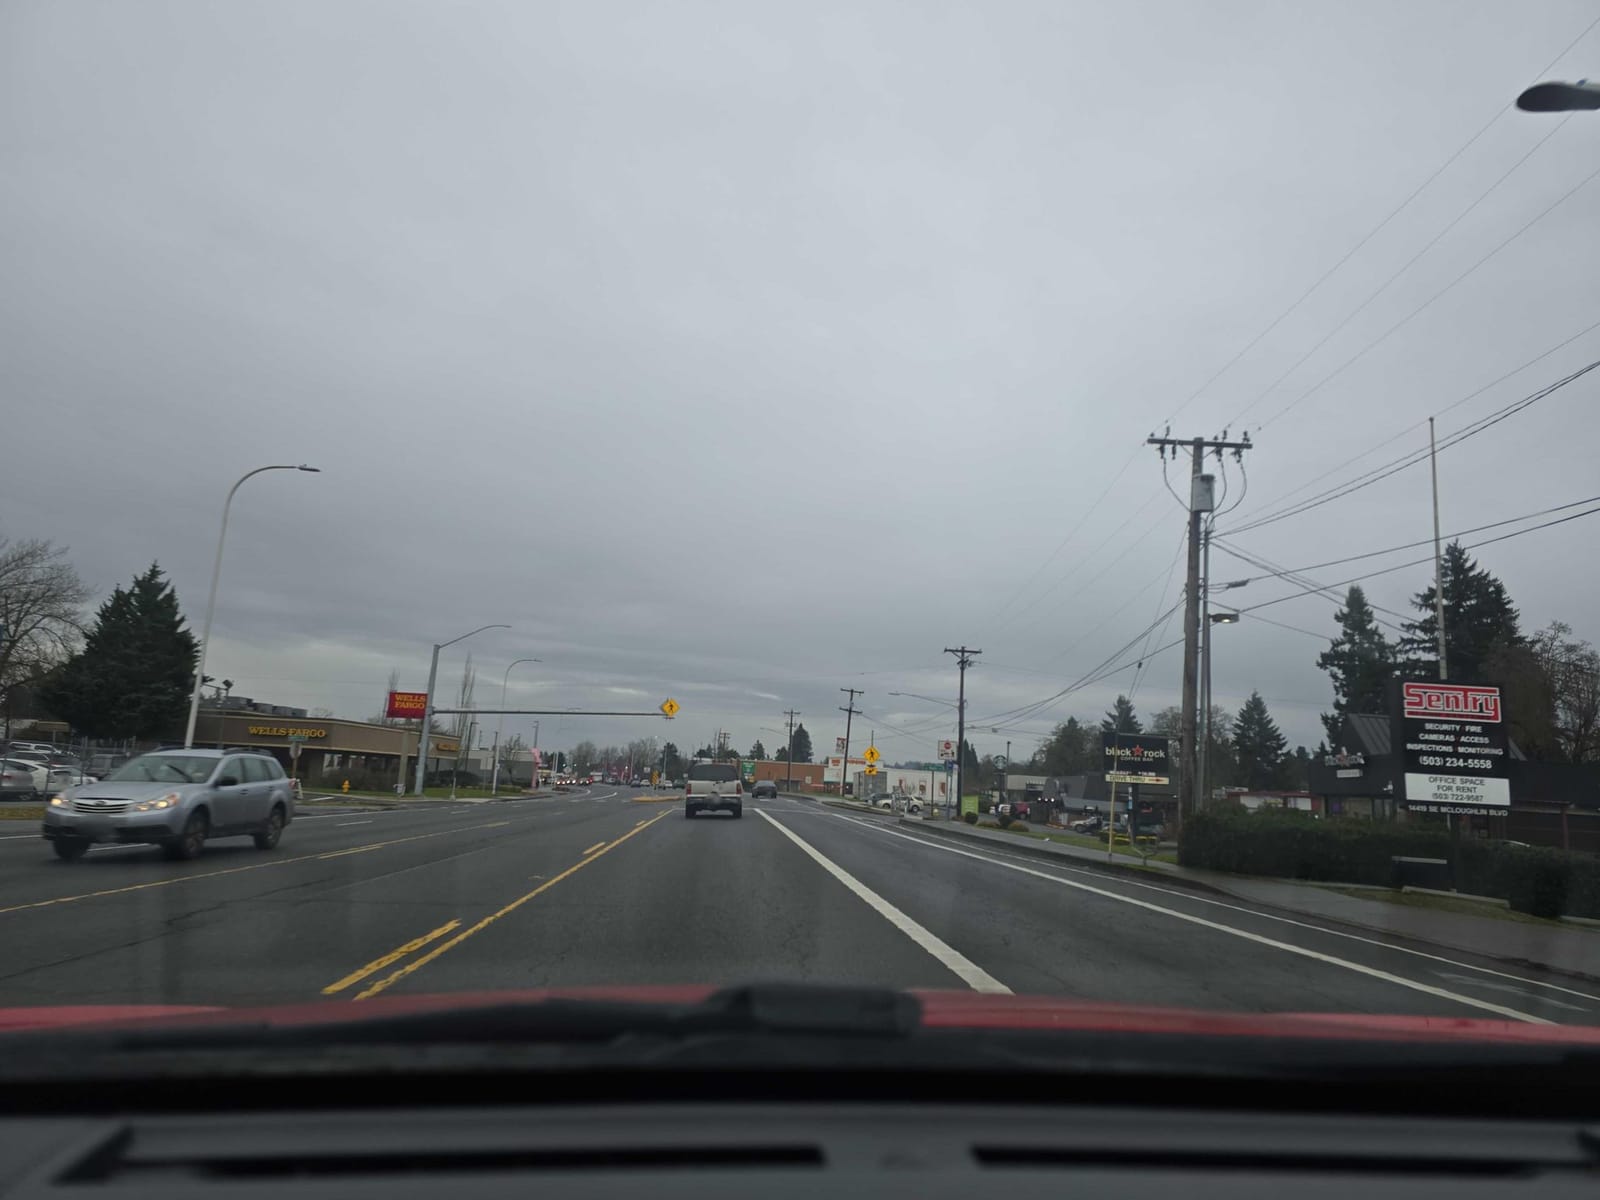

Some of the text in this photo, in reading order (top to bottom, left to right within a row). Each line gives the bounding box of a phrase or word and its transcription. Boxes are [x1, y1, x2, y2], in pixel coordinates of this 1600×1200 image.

[395, 694, 427, 702] WELLS
[394, 702, 425, 710] FARGO
[248, 726, 327, 738] WELLS FARGO
[1424, 722, 1482, 733] SECURITY FIRE
[1418, 733, 1490, 744] CAMERAS ACCESS
[1143, 749, 1166, 759] rock
[1406, 743, 1504, 756] INSPECTIONS MONITORING
[1419, 755, 1493, 769] (503) 234-5558
[1428, 776, 1486, 786] OFFICE SPACE
[1436, 785, 1478, 794] FOR RENT
[1428, 805, 1440, 813] SE
[1489, 808, 1509, 817] BLVD
